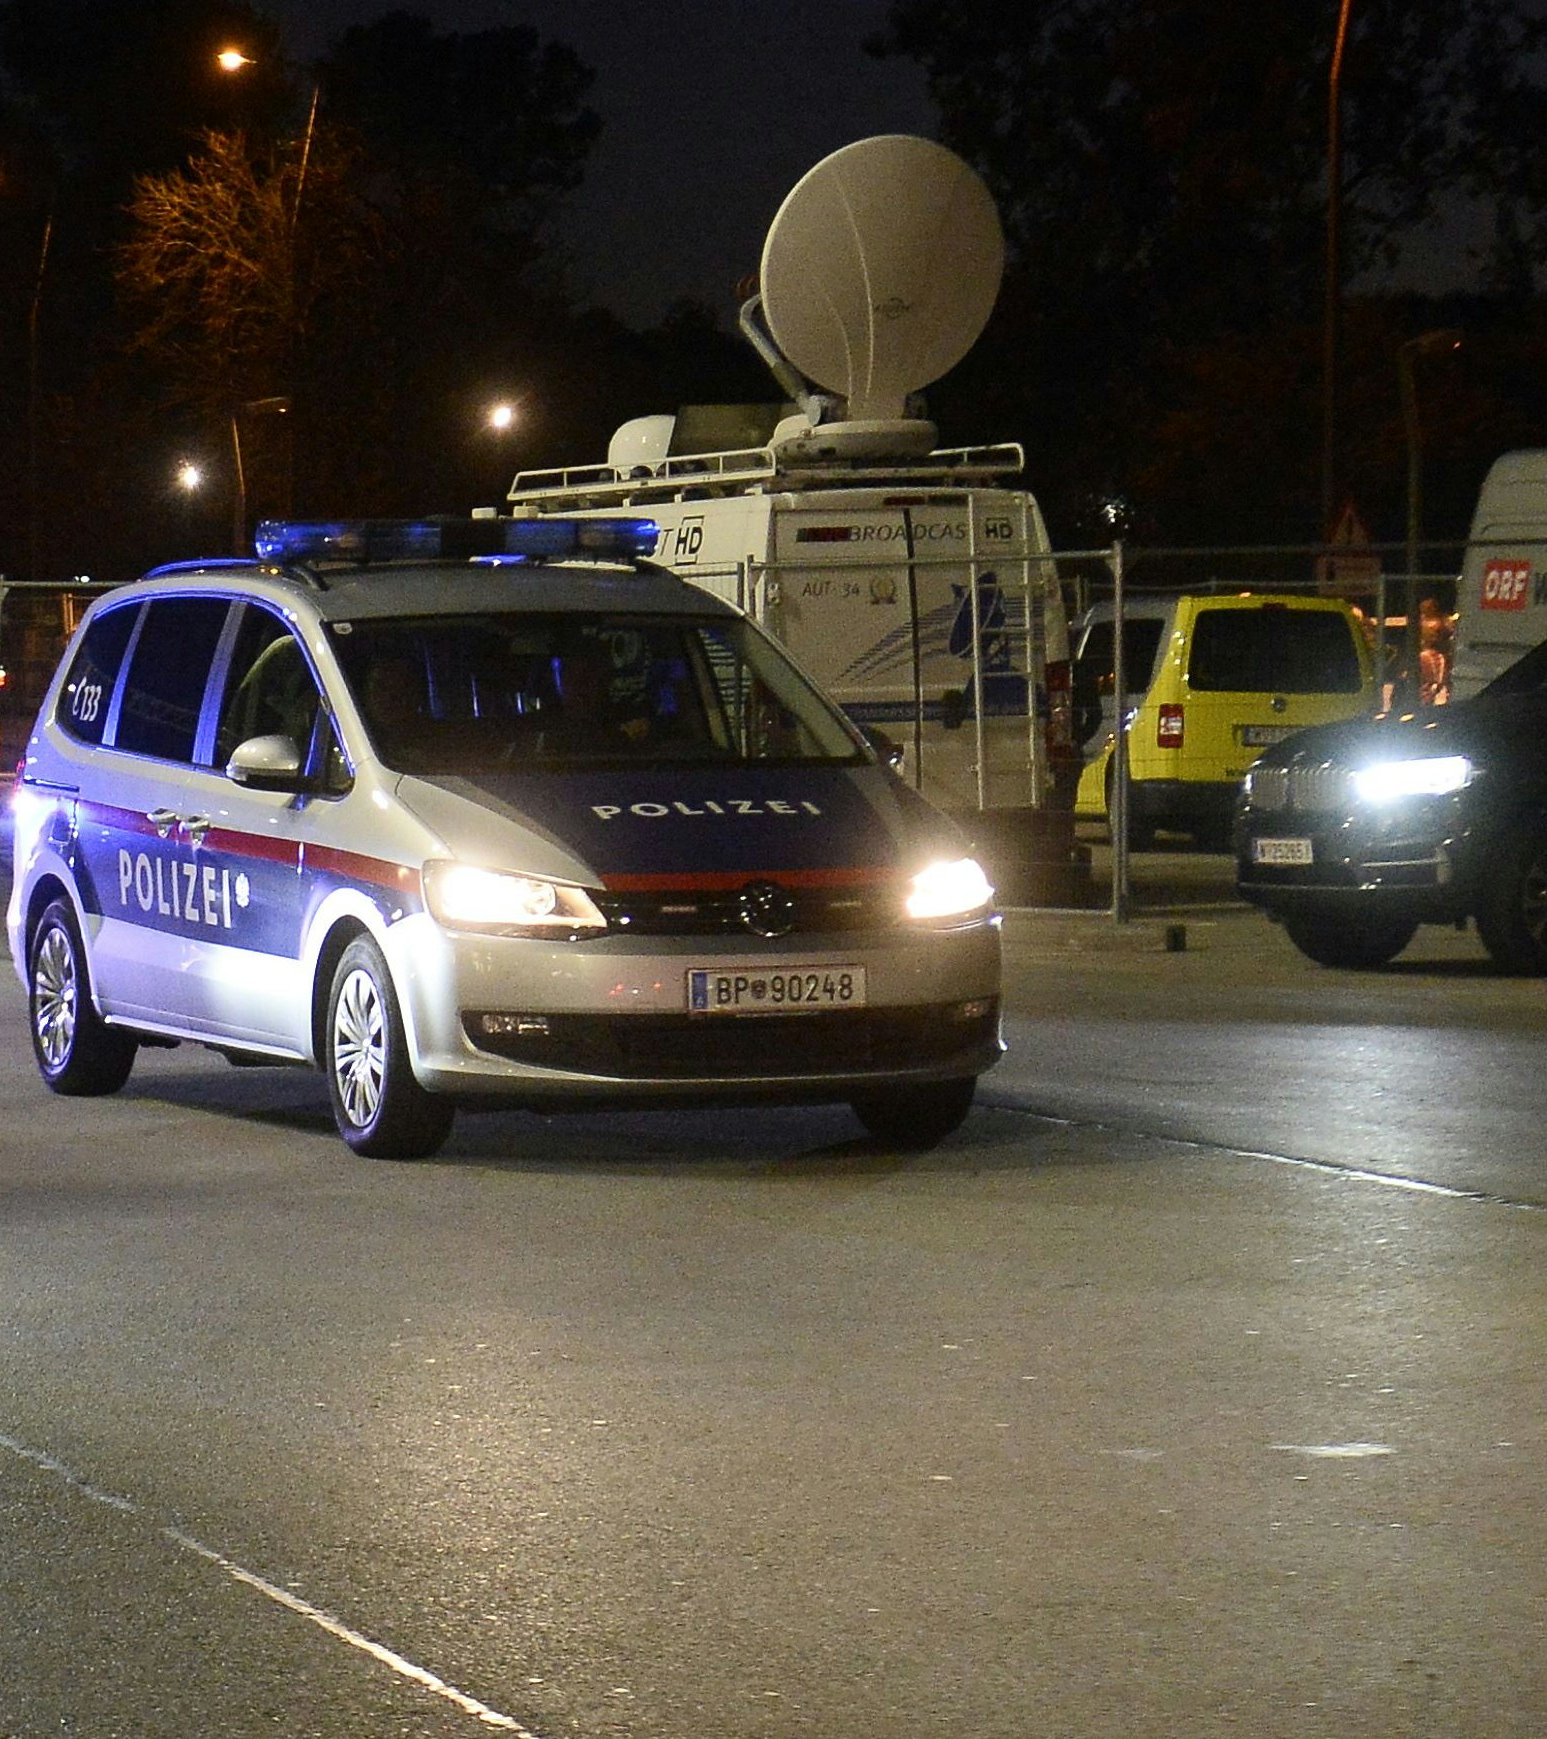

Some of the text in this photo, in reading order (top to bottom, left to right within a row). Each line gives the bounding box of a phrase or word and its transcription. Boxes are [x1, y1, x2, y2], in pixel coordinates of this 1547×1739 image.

[675, 526, 703, 555] HD
[849, 522, 1013, 542] BROADCAS HD
[1486, 570, 1528, 601] ORF
[591, 800, 821, 819] POLIZEI
[118, 848, 231, 928] POLIZEI
[716, 973, 852, 1004] BP 90248
